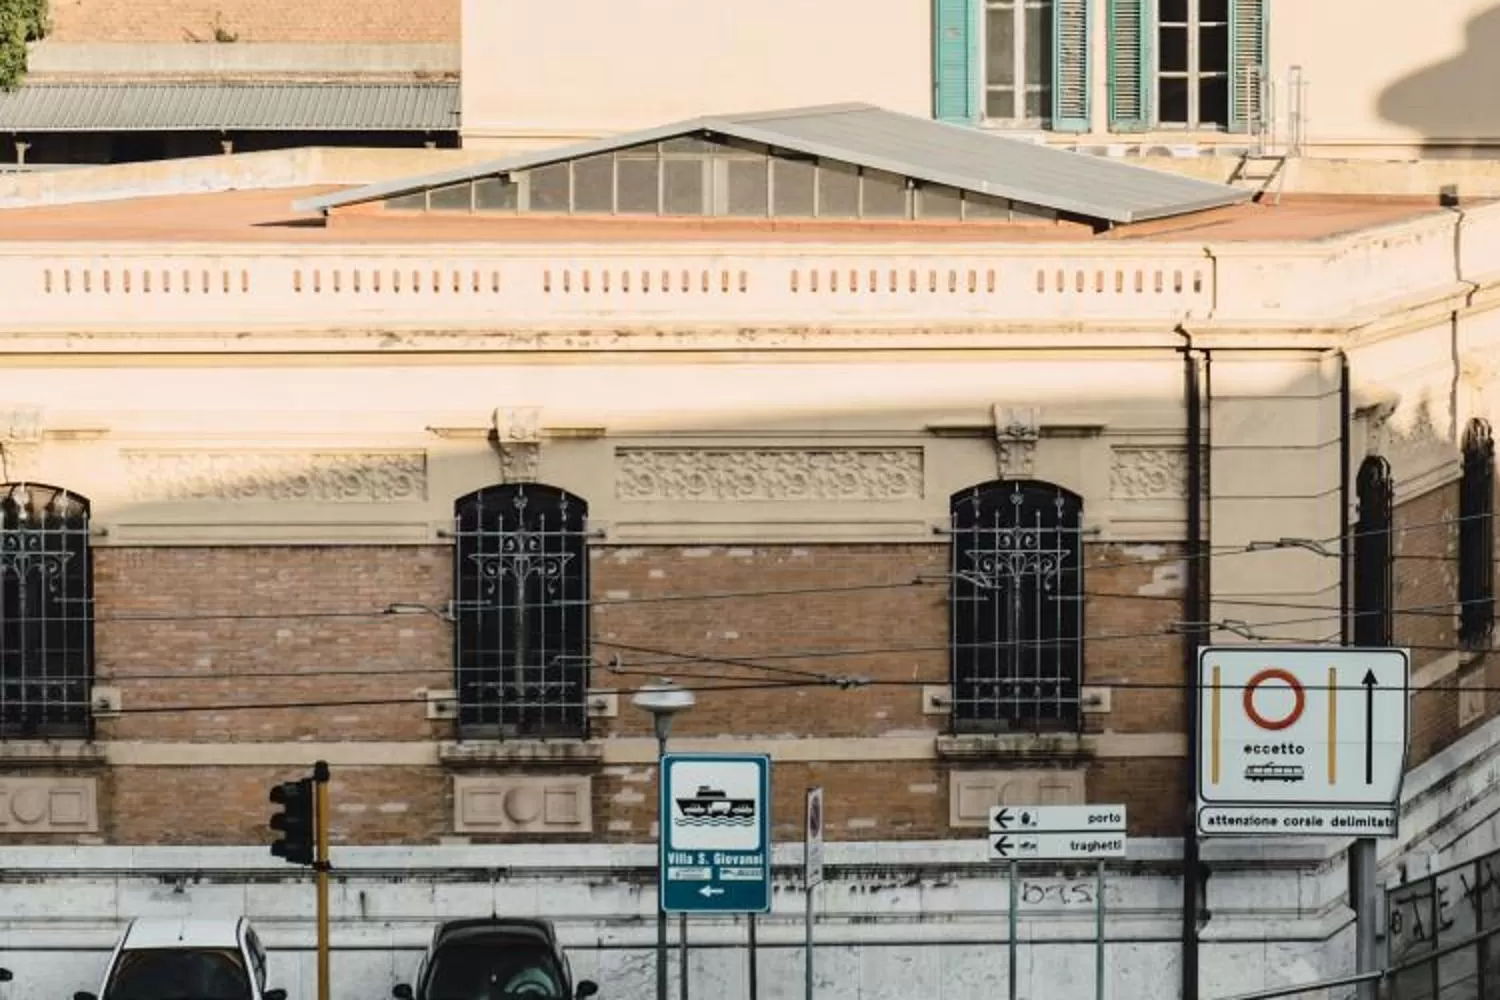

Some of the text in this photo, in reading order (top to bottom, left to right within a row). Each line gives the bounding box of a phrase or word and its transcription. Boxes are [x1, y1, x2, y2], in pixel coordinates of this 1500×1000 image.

[1243, 743, 1305, 755] eccetto
[1088, 812, 1121, 824] porto
[1207, 815, 1277, 826] attenzione
[1283, 815, 1324, 827] corsie
[1070, 839, 1122, 852] traghetti
[668, 851, 693, 865] Villa
[697, 851, 710, 865] S.
